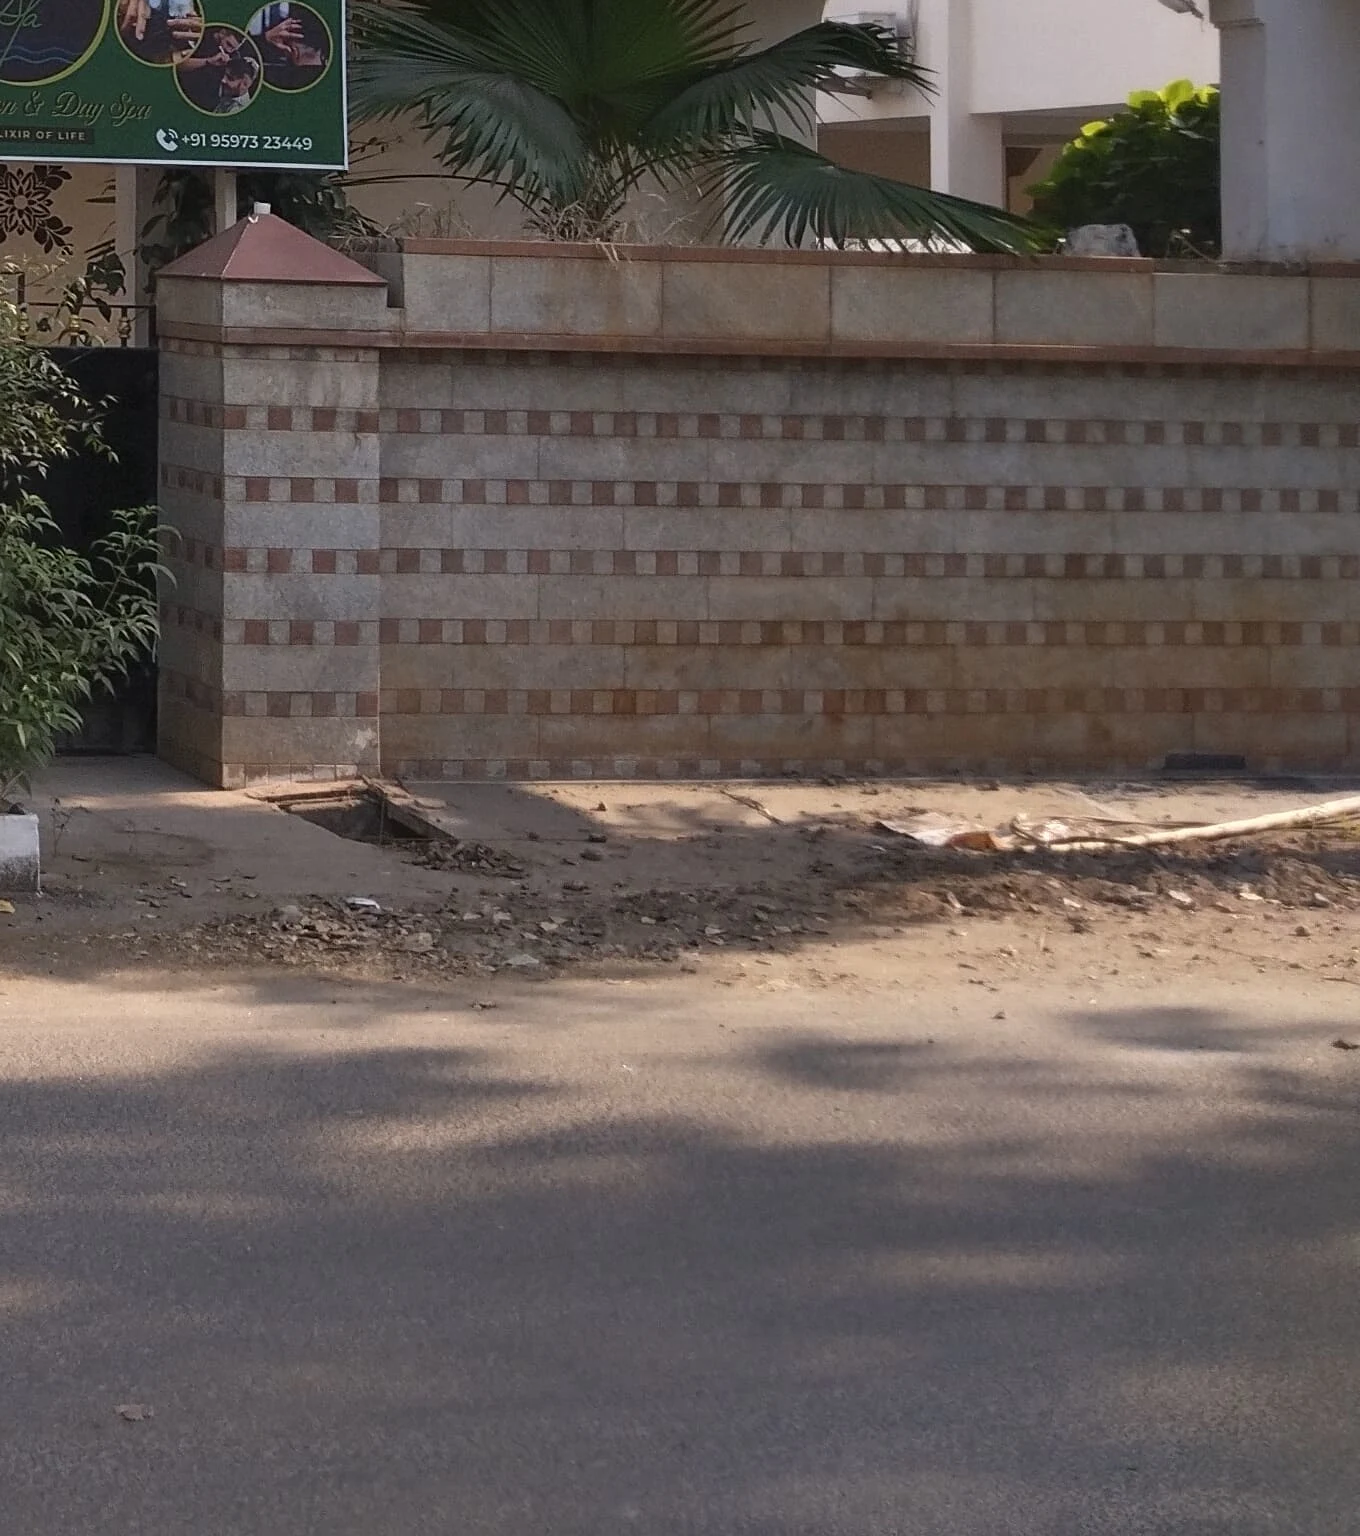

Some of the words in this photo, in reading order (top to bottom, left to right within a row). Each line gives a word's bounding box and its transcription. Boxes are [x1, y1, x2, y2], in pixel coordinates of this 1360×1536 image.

[24, 90, 45, 117] &
[51, 91, 104, 126] Day
[110, 92, 152, 127] Spa
[36, 130, 53, 140] OF
[58, 130, 85, 141] LIFE
[181, 133, 206, 147] +91
[210, 134, 258, 149] 95973
[263, 136, 313, 150] 23449
